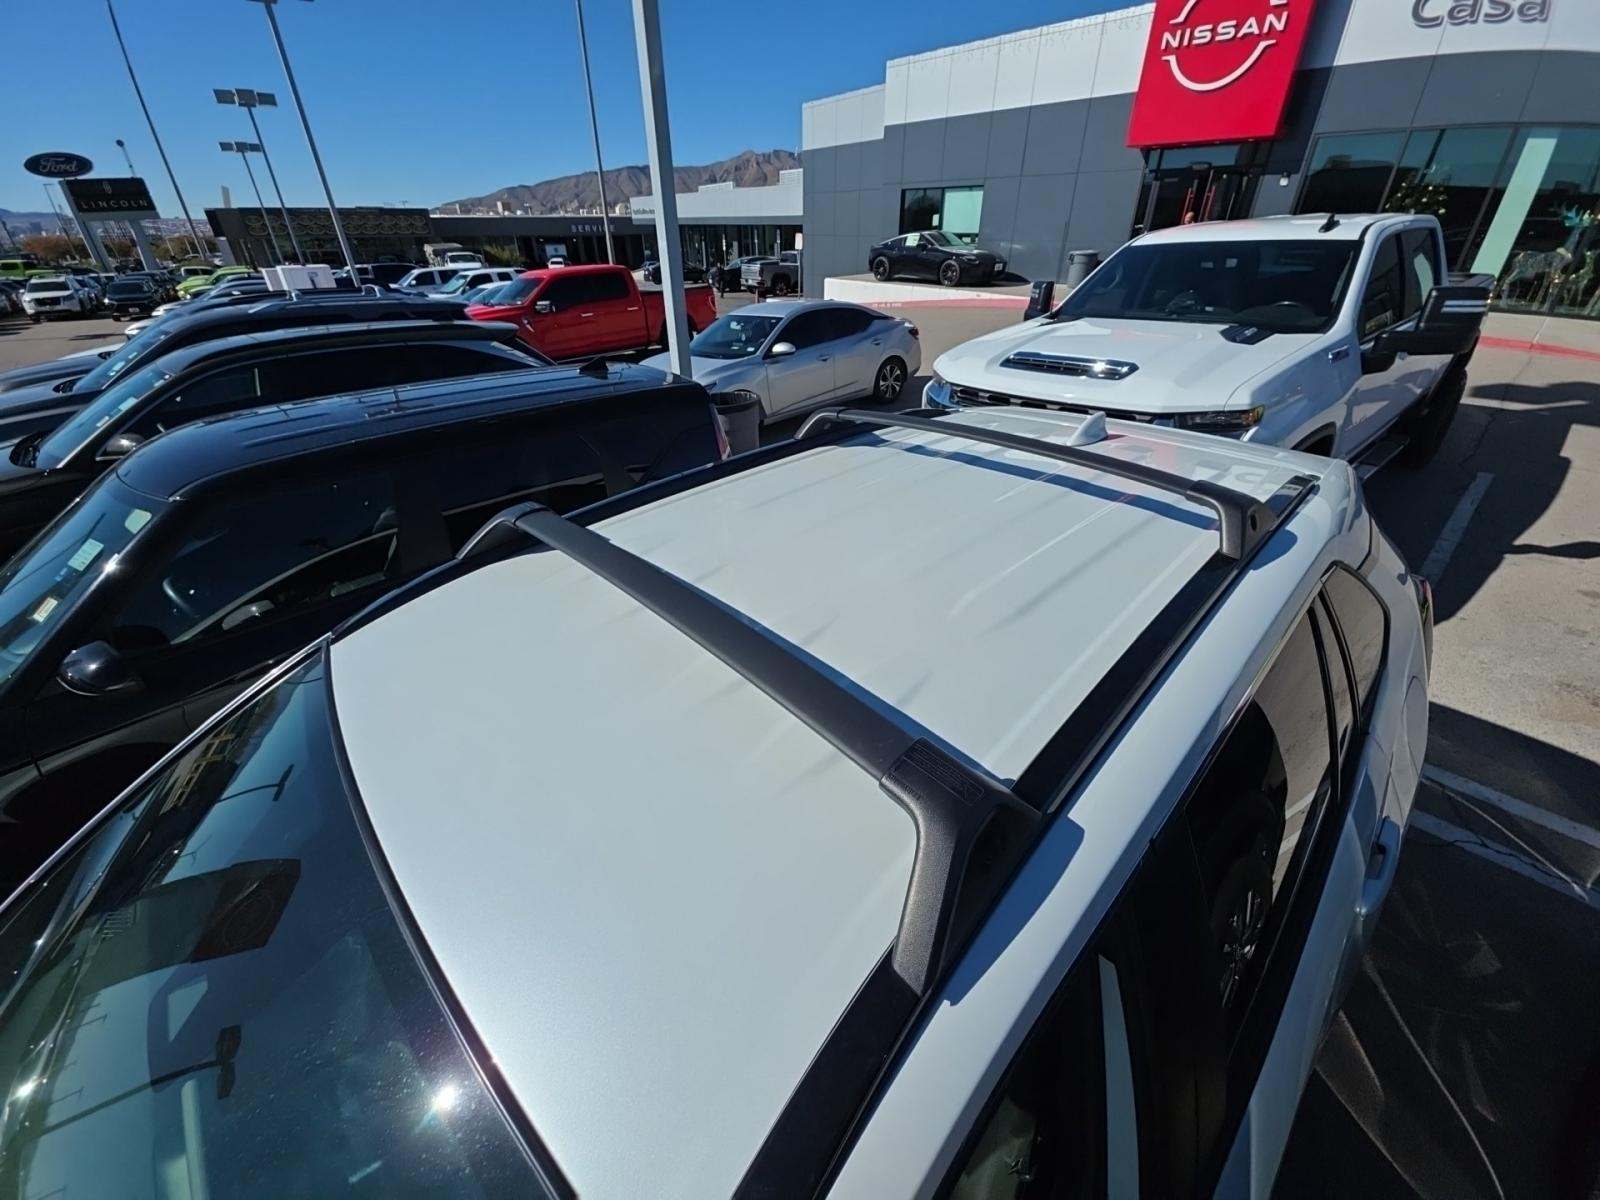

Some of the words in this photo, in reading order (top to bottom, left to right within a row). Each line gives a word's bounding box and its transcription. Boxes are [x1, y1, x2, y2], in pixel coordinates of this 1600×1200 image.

[1411, 0, 1550, 28] Casa
[1160, 11, 1288, 50] NISSAN
[40, 158, 78, 172] Ford
[80, 199, 148, 208] LINCOLN
